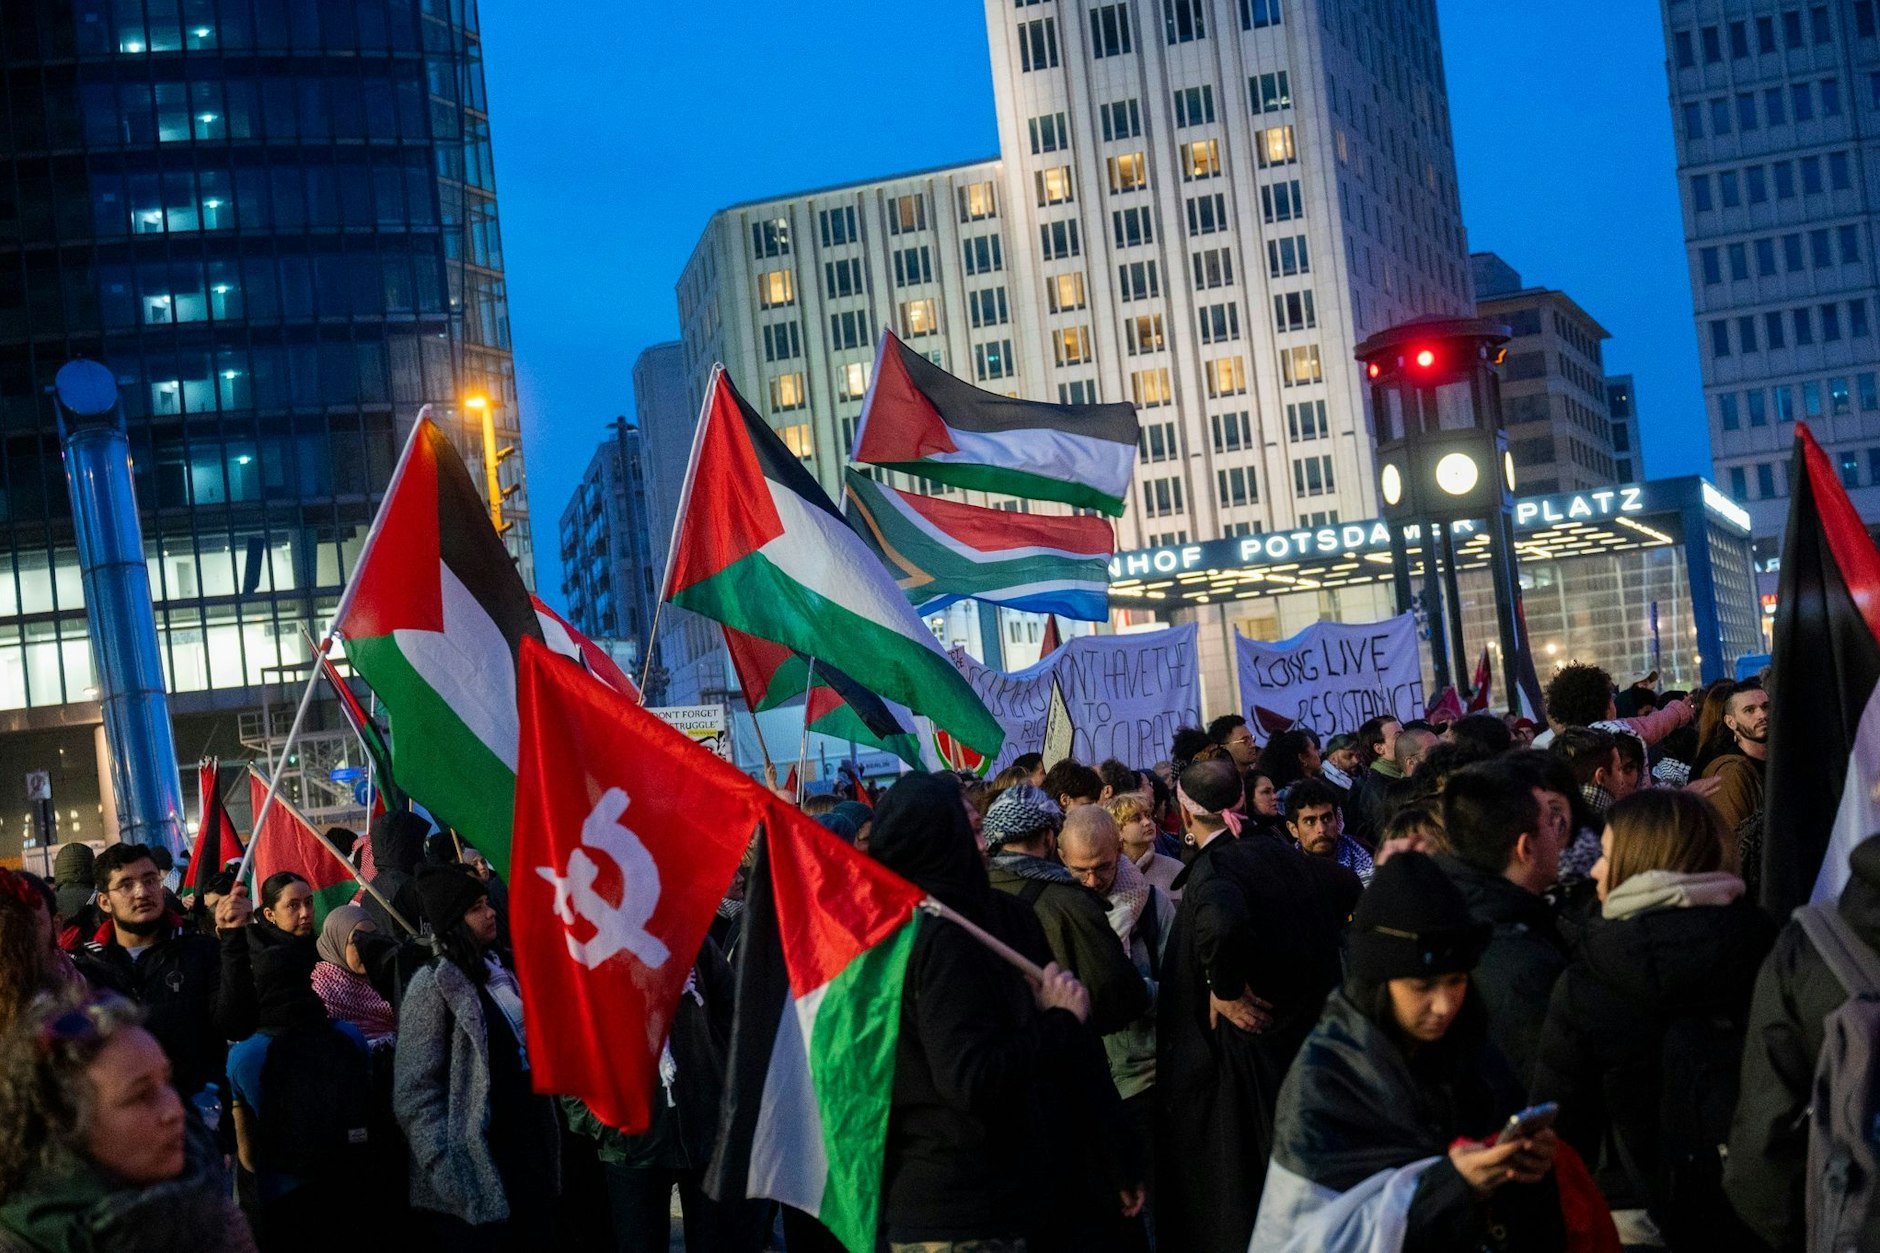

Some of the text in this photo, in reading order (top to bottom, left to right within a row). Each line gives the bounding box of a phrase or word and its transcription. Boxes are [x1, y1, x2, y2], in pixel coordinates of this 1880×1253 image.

[1108, 546, 1202, 578] NHOF
[1517, 487, 1643, 525] PLATZ
[1151, 641, 1191, 694] THE
[1253, 634, 1390, 689] LONG LIVE
[668, 720, 719, 730] TRUGGLE"
[682, 709, 719, 719] FORGET
[1083, 701, 1112, 723] TO
